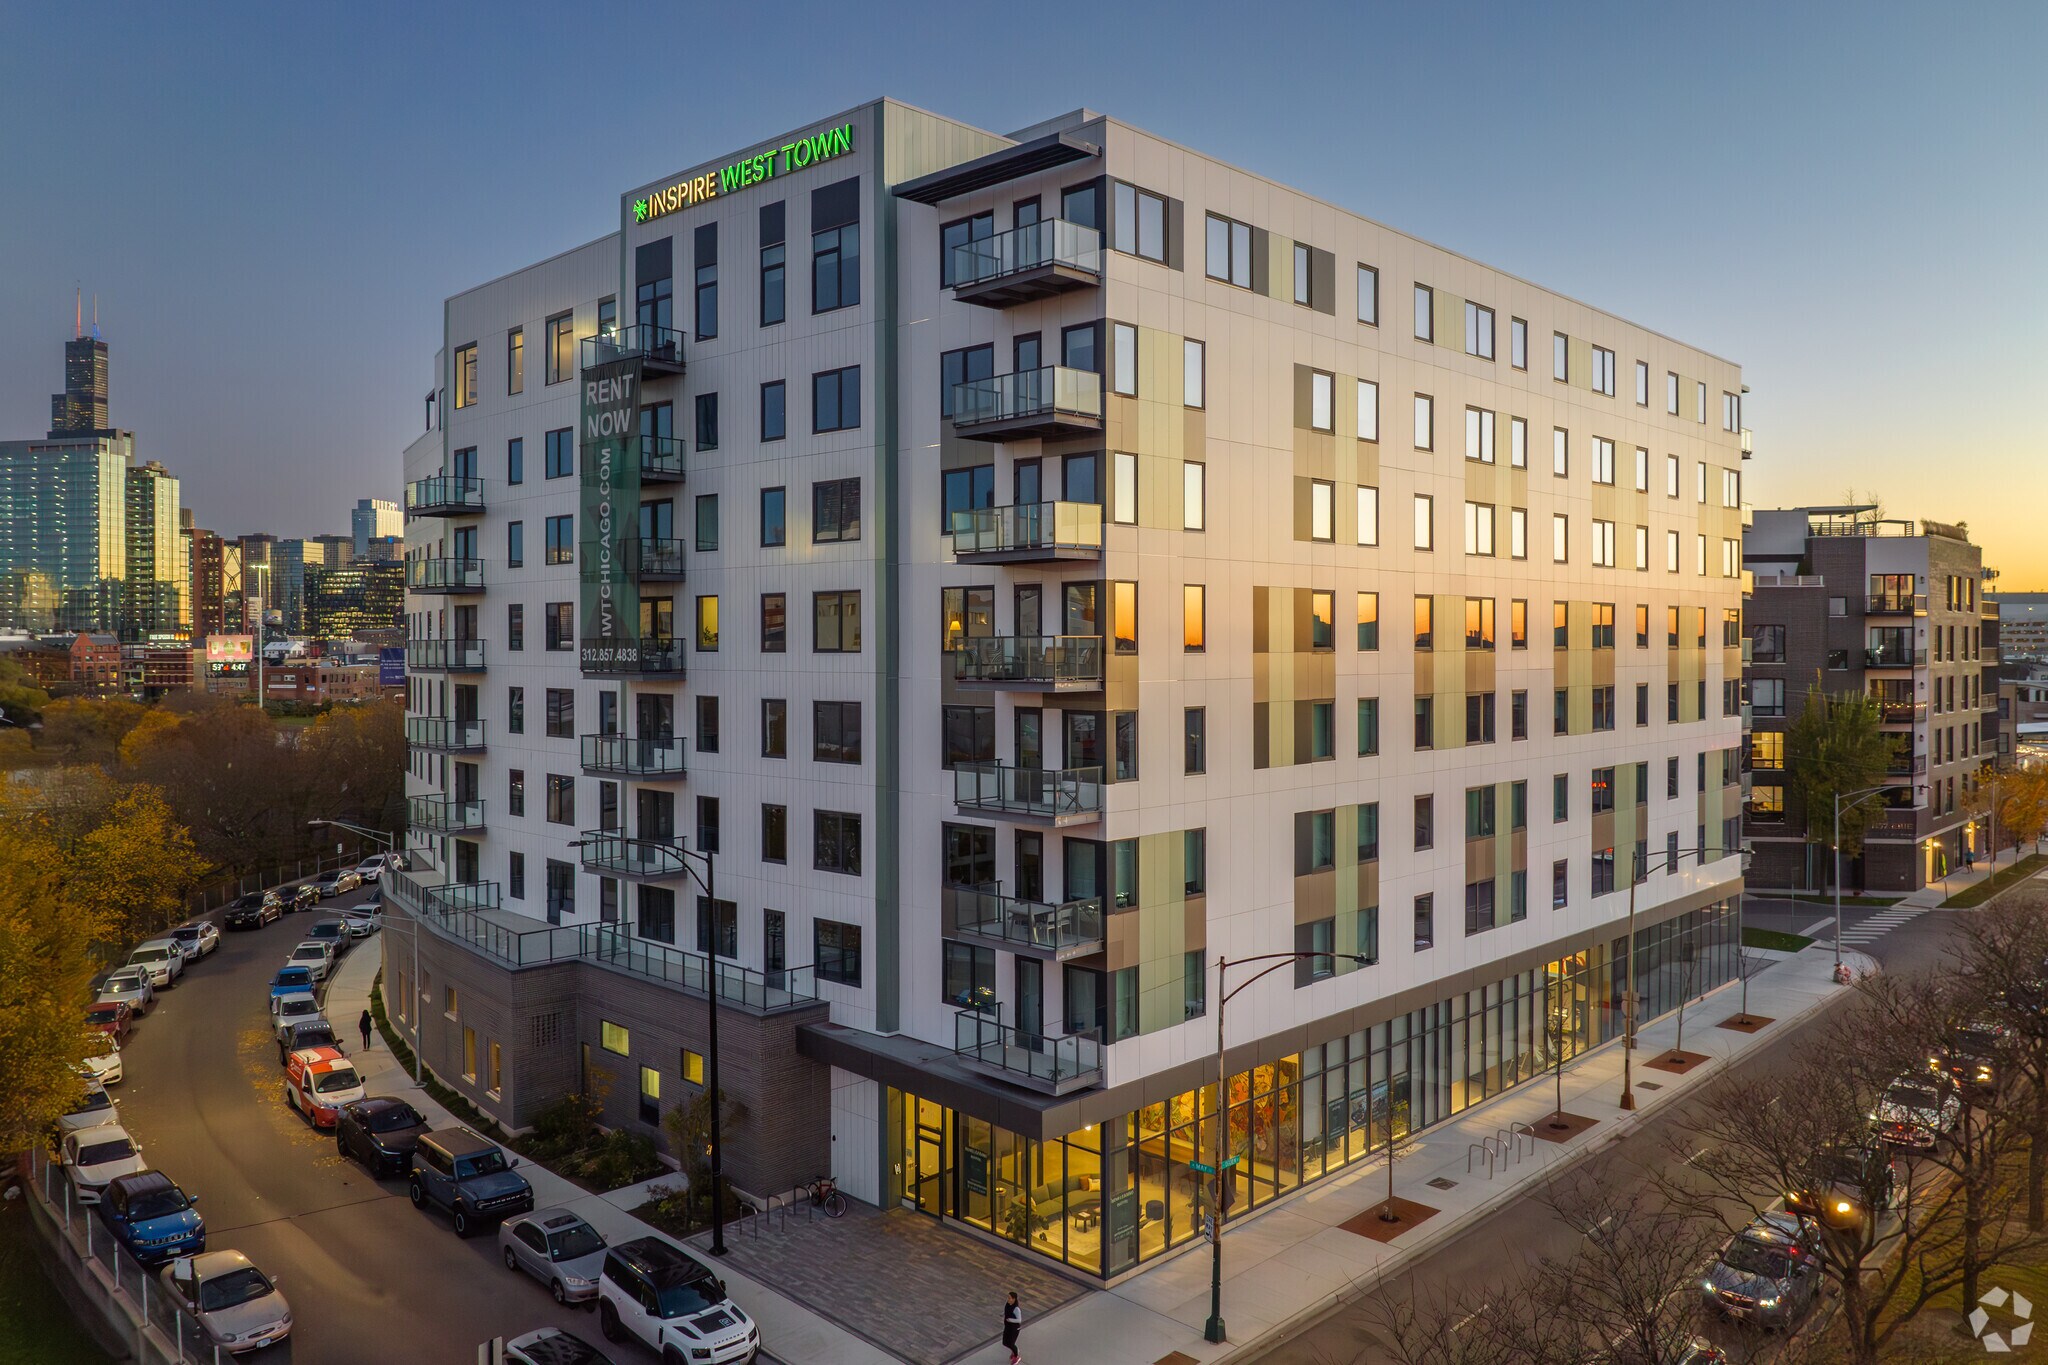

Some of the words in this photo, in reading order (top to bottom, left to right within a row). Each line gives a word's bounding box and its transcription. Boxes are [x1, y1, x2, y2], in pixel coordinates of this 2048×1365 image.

[649, 171, 719, 219] INSPIRE
[720, 149, 780, 193] WEST
[781, 123, 853, 172] TOWN
[586, 373, 634, 406] RENT
[587, 407, 632, 439] NOW
[599, 447, 612, 638] IWTCHICAGO.COM
[231, 663, 246, 671] 4:47
[581, 647, 638, 663] 312.857.4838
[1195, 1164, 1208, 1172] MAY
